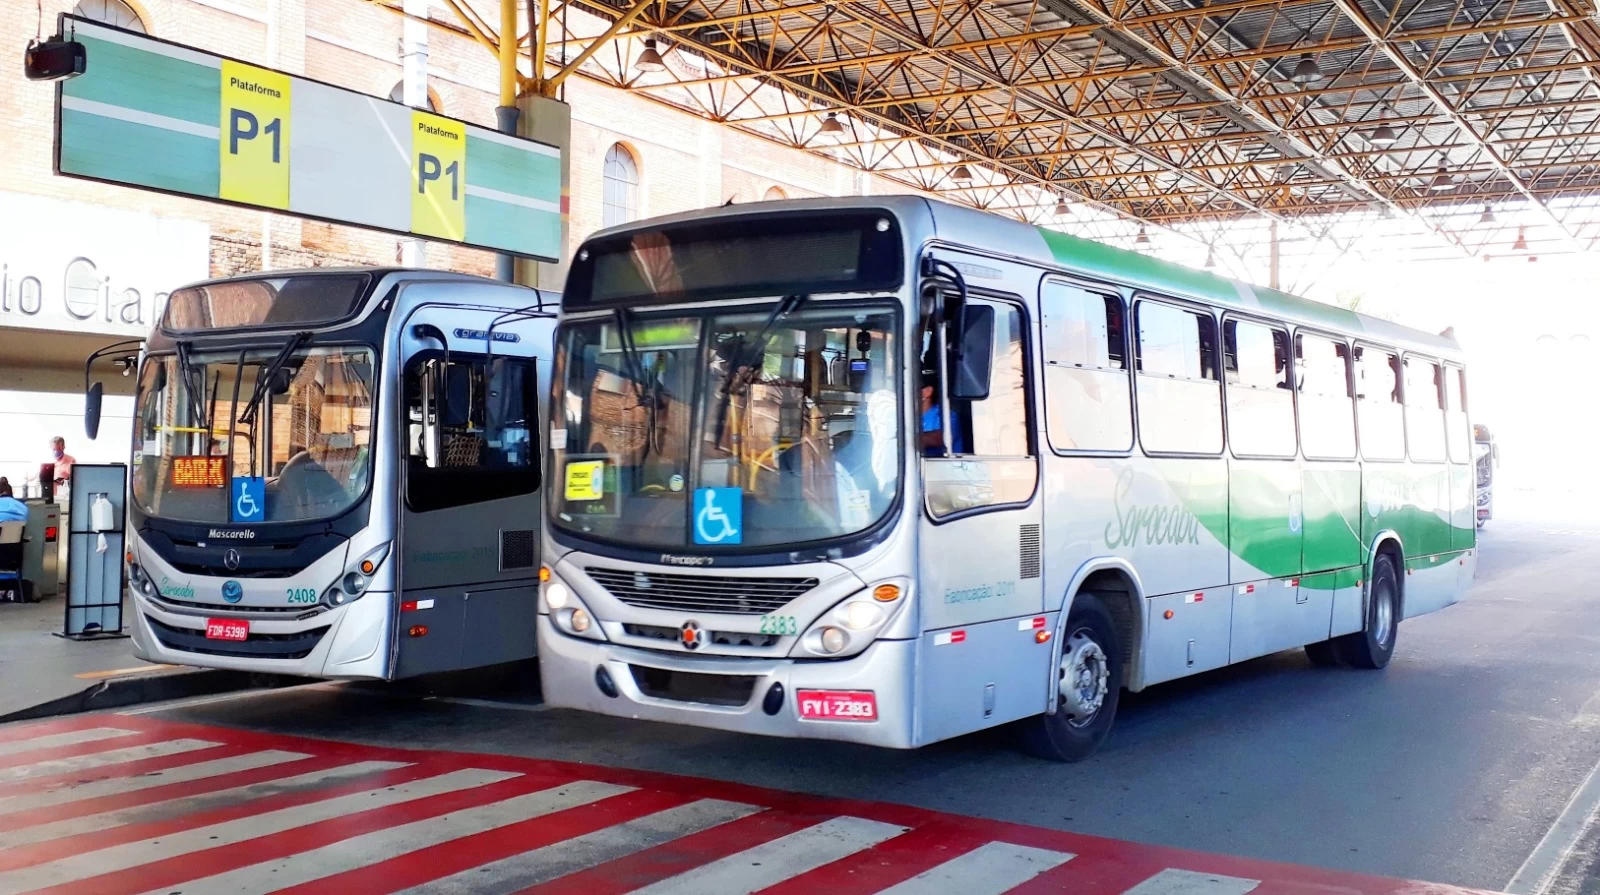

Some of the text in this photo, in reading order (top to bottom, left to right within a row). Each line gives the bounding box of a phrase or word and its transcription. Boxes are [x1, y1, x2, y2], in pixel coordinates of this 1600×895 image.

[230, 77, 281, 98] Plataforma
[230, 107, 281, 164] P1
[418, 122, 459, 141] Plataforma
[418, 152, 458, 201] P1
[208, 528, 256, 539] Mascarello
[286, 588, 317, 604] 2408
[760, 615, 797, 635] 2383
